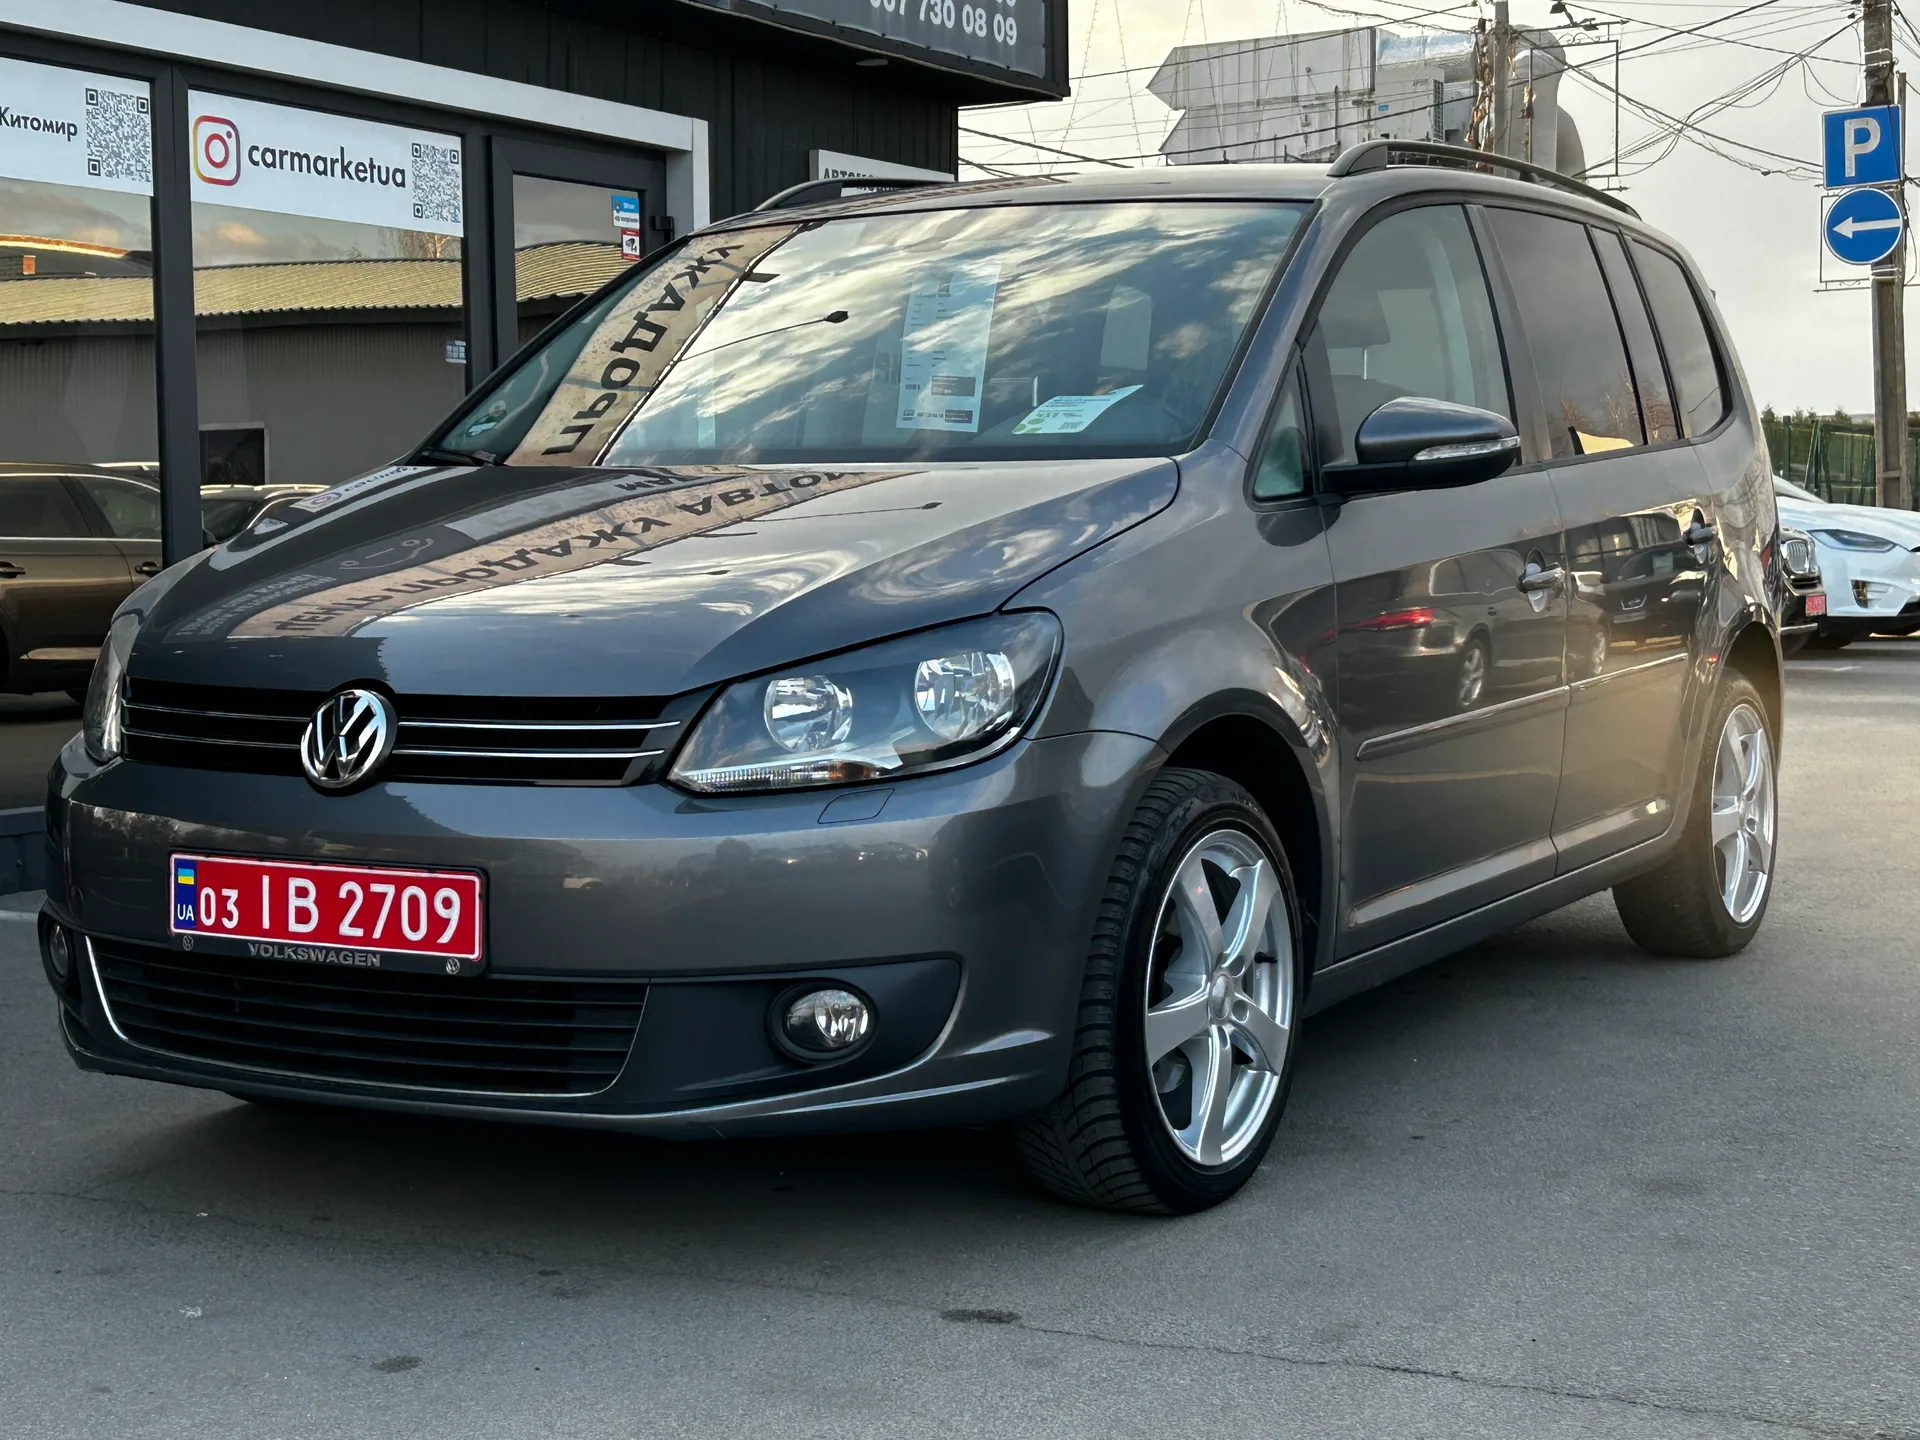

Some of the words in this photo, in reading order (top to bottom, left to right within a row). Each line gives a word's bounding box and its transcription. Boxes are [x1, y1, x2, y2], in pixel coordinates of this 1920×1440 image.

[919, 0, 956, 29] 730
[962, 4, 987, 37] 08
[993, 13, 1018, 46] 09
[247, 144, 407, 188] carmarketua
[1843, 117, 1881, 178] P
[177, 904, 195, 921] UA
[200, 886, 239, 929] 03
[338, 880, 461, 944] 2709
[247, 942, 382, 967] VOLKSWAGEN
